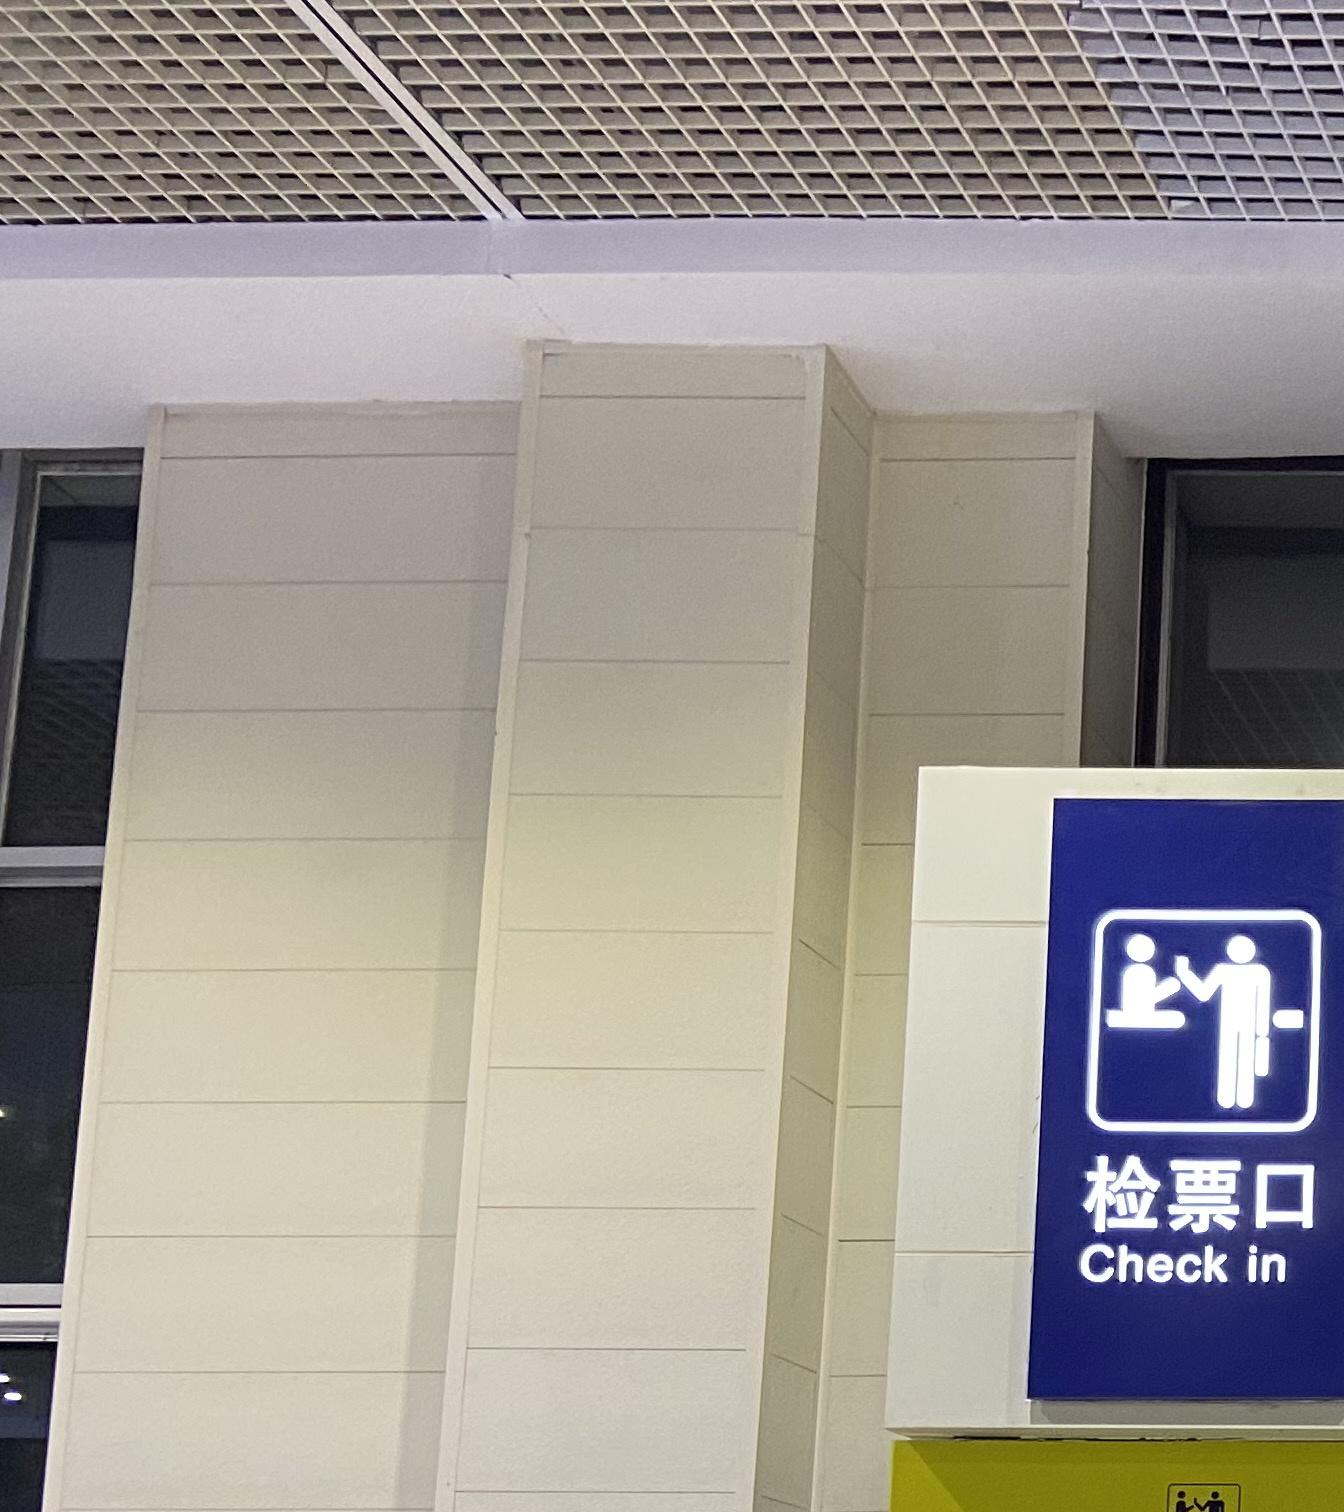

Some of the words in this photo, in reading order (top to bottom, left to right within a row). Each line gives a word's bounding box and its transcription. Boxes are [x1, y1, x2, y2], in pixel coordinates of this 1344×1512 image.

[1082, 1154, 1316, 1234] 检票口
[1078, 1243, 1229, 1285] Check
[1247, 1243, 1288, 1284] in
